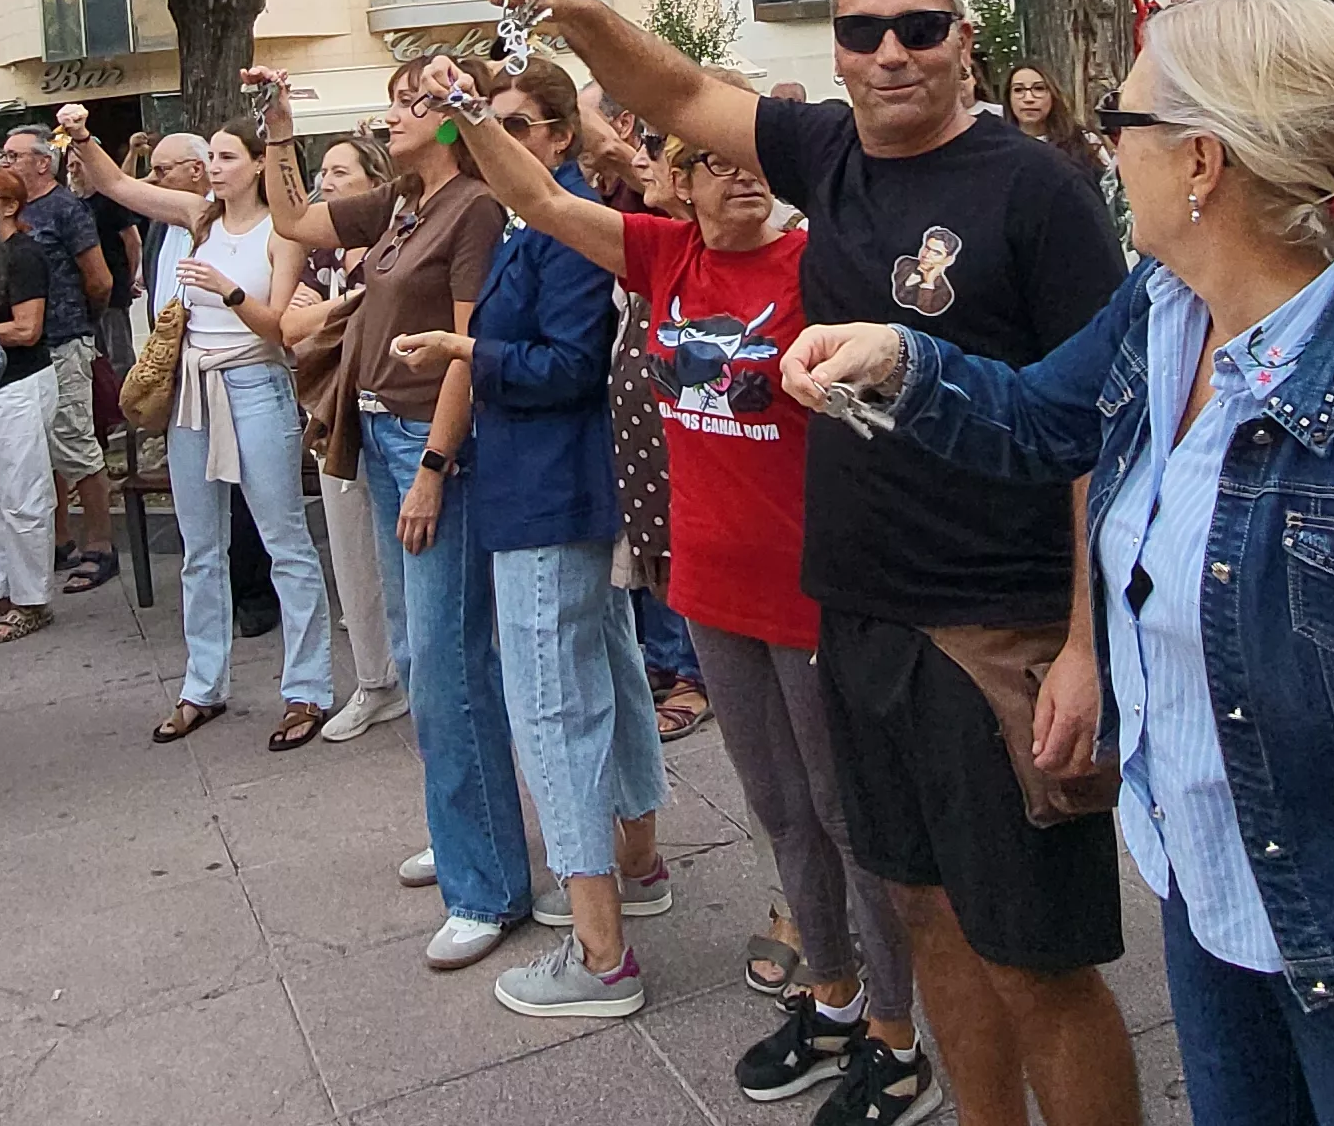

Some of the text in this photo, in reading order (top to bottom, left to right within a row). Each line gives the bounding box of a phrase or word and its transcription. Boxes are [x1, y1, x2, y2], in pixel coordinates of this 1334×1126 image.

[41, 58, 124, 93] Bar
[702, 416, 744, 436] CANAL
[743, 423, 780, 441] ROYA
